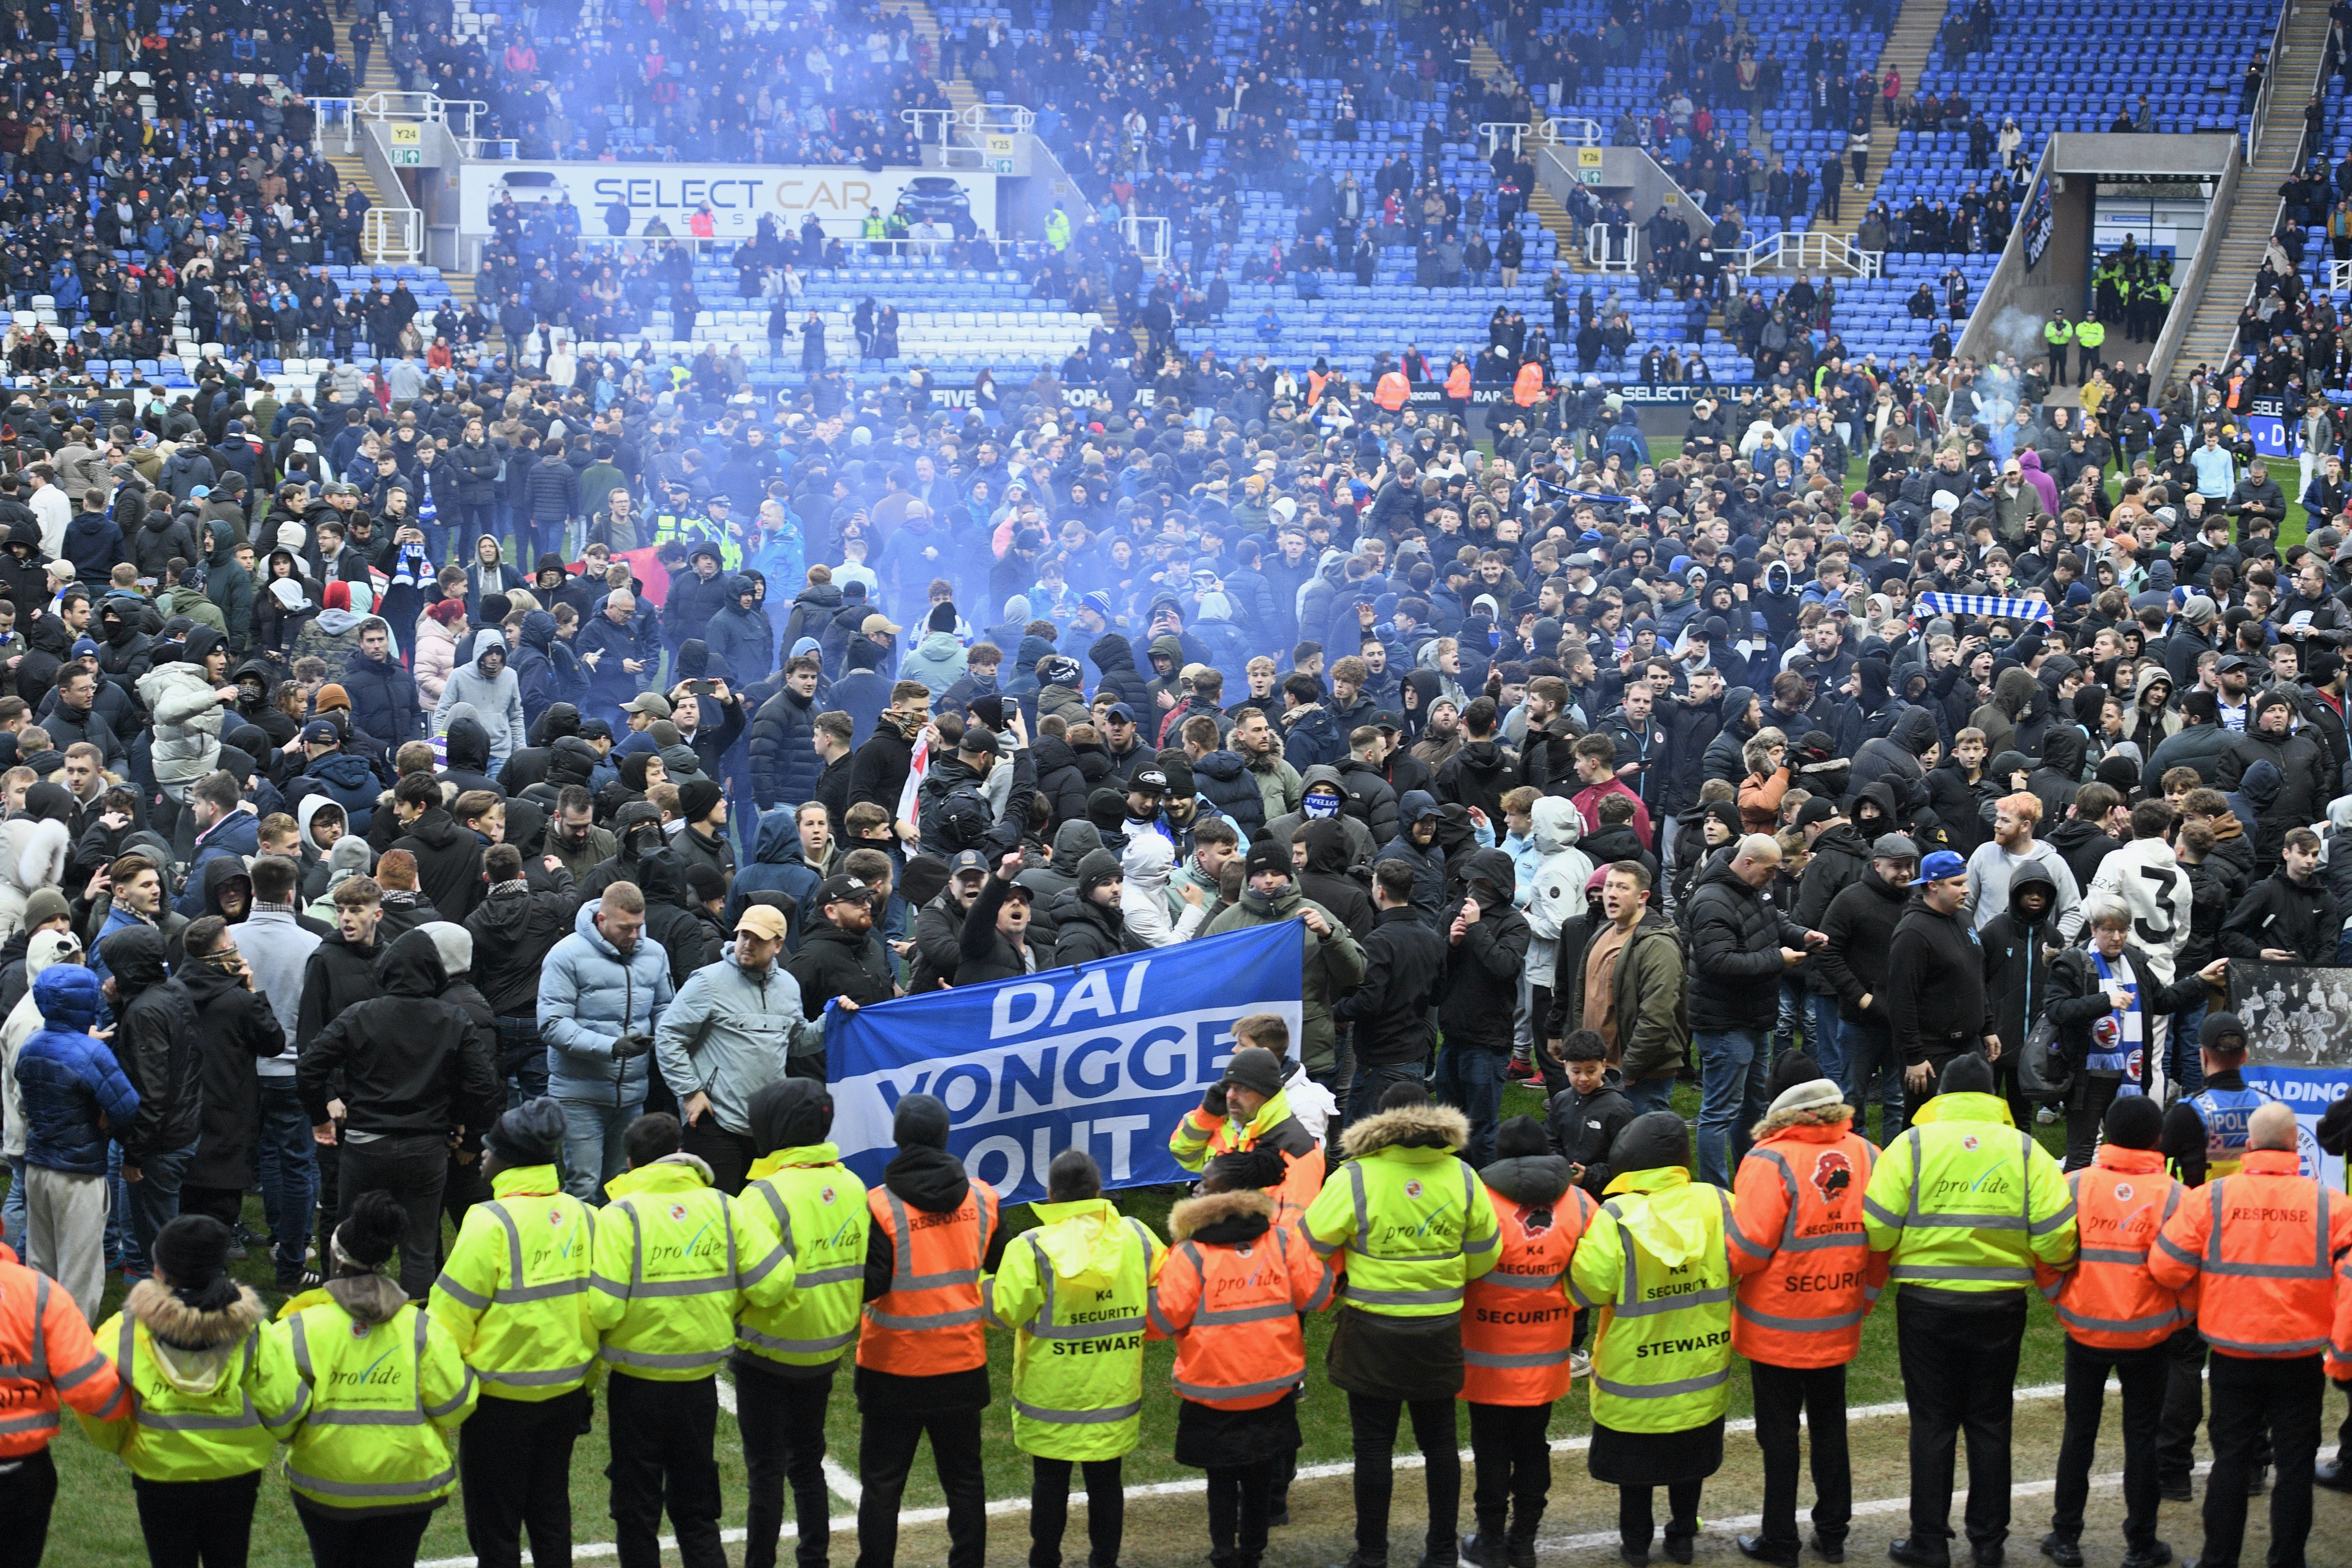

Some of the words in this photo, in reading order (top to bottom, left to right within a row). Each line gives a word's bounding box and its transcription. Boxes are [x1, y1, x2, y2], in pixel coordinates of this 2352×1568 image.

[396, 129, 416, 139] Y24
[991, 140, 1010, 150] Y25
[1581, 152, 1599, 163] Y26
[593, 179, 763, 208] SELECT
[776, 180, 872, 210] CAR
[1622, 386, 1690, 401] SELECT
[1690, 386, 1731, 400] CAR
[2134, 865, 2177, 944] 3
[989, 960, 1151, 1039] DAI
[1936, 1168, 2009, 1197] provide
[909, 1208, 976, 1232] RESPONSE
[1827, 1211, 1842, 1220] K4
[2232, 1207, 2308, 1222] RESPONSE
[1381, 1211, 1452, 1244] provide
[649, 1228, 721, 1265] provide
[1526, 1245, 1544, 1255] K4
[1498, 1263, 1563, 1274] SECURITY
[1214, 1263, 1282, 1297] provide
[1647, 1278, 1707, 1299] SECURITY
[1095, 1290, 1113, 1301] K4
[1070, 1306, 1139, 1325] SECURITY
[1476, 1307, 1569, 1325] SECURITY
[1636, 1330, 1730, 1358] STEWARD
